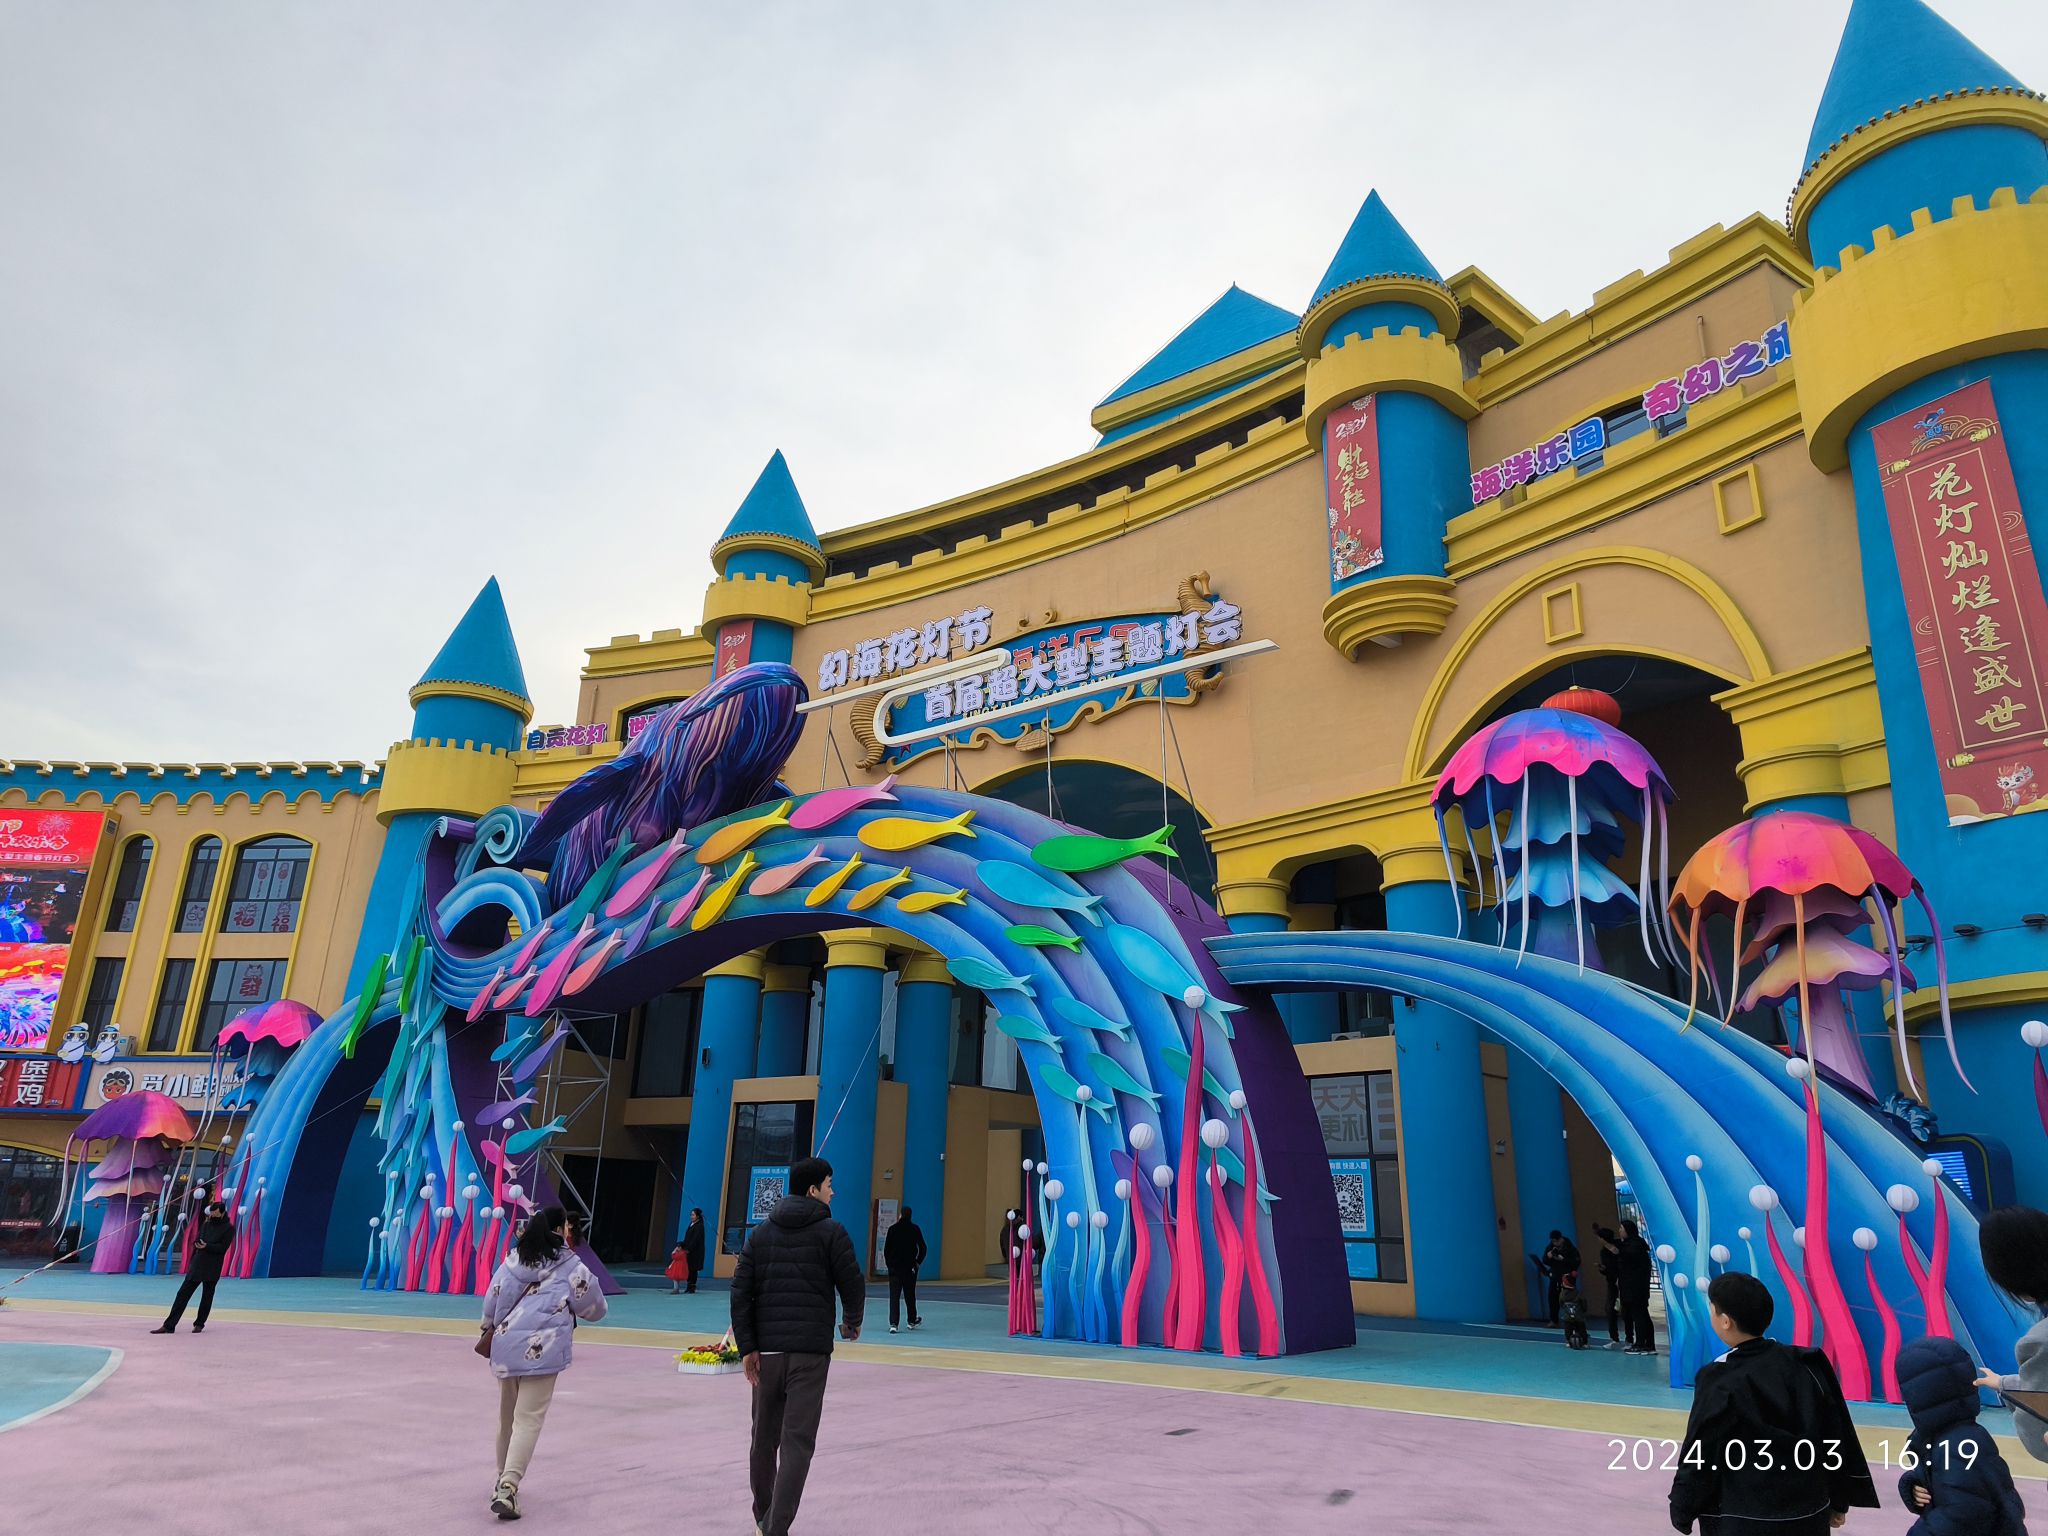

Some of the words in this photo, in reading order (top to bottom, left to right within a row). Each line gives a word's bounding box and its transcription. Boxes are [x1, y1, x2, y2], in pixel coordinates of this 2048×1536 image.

[1470, 416, 1606, 505] 海洋乐园
[817, 604, 993, 692] 幻海花灯节
[1927, 460, 2027, 734] 花灯灿烂逢盛世
[924, 600, 1242, 724] 首届超大型主题灯会
